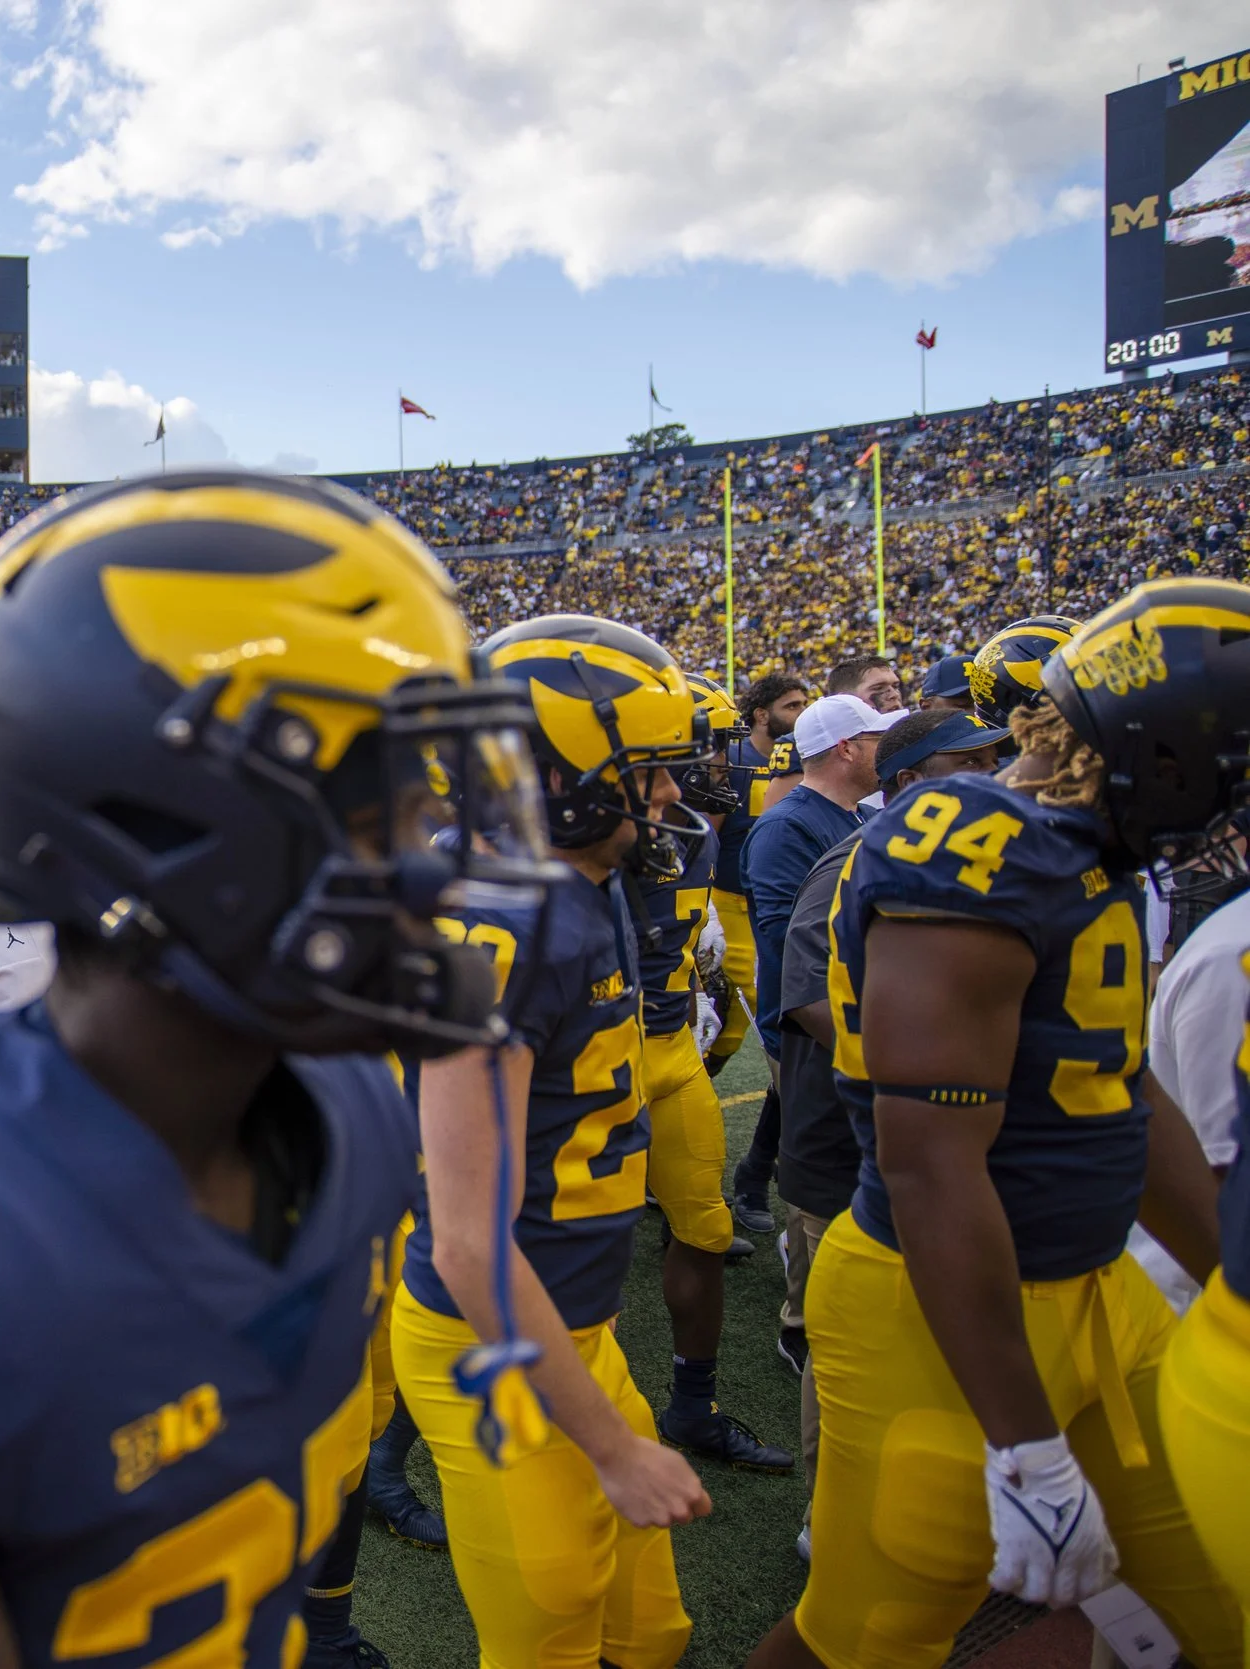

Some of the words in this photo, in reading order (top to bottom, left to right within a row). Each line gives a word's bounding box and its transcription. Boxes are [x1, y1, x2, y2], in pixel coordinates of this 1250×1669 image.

[1111, 195, 1159, 236] M
[1107, 331, 1181, 365] 20:00
[1207, 326, 1233, 347] M
[886, 791, 1024, 895] 94
[665, 887, 709, 992] 7
[552, 1012, 649, 1222] 2
[929, 1089, 987, 1105] JORDAN
